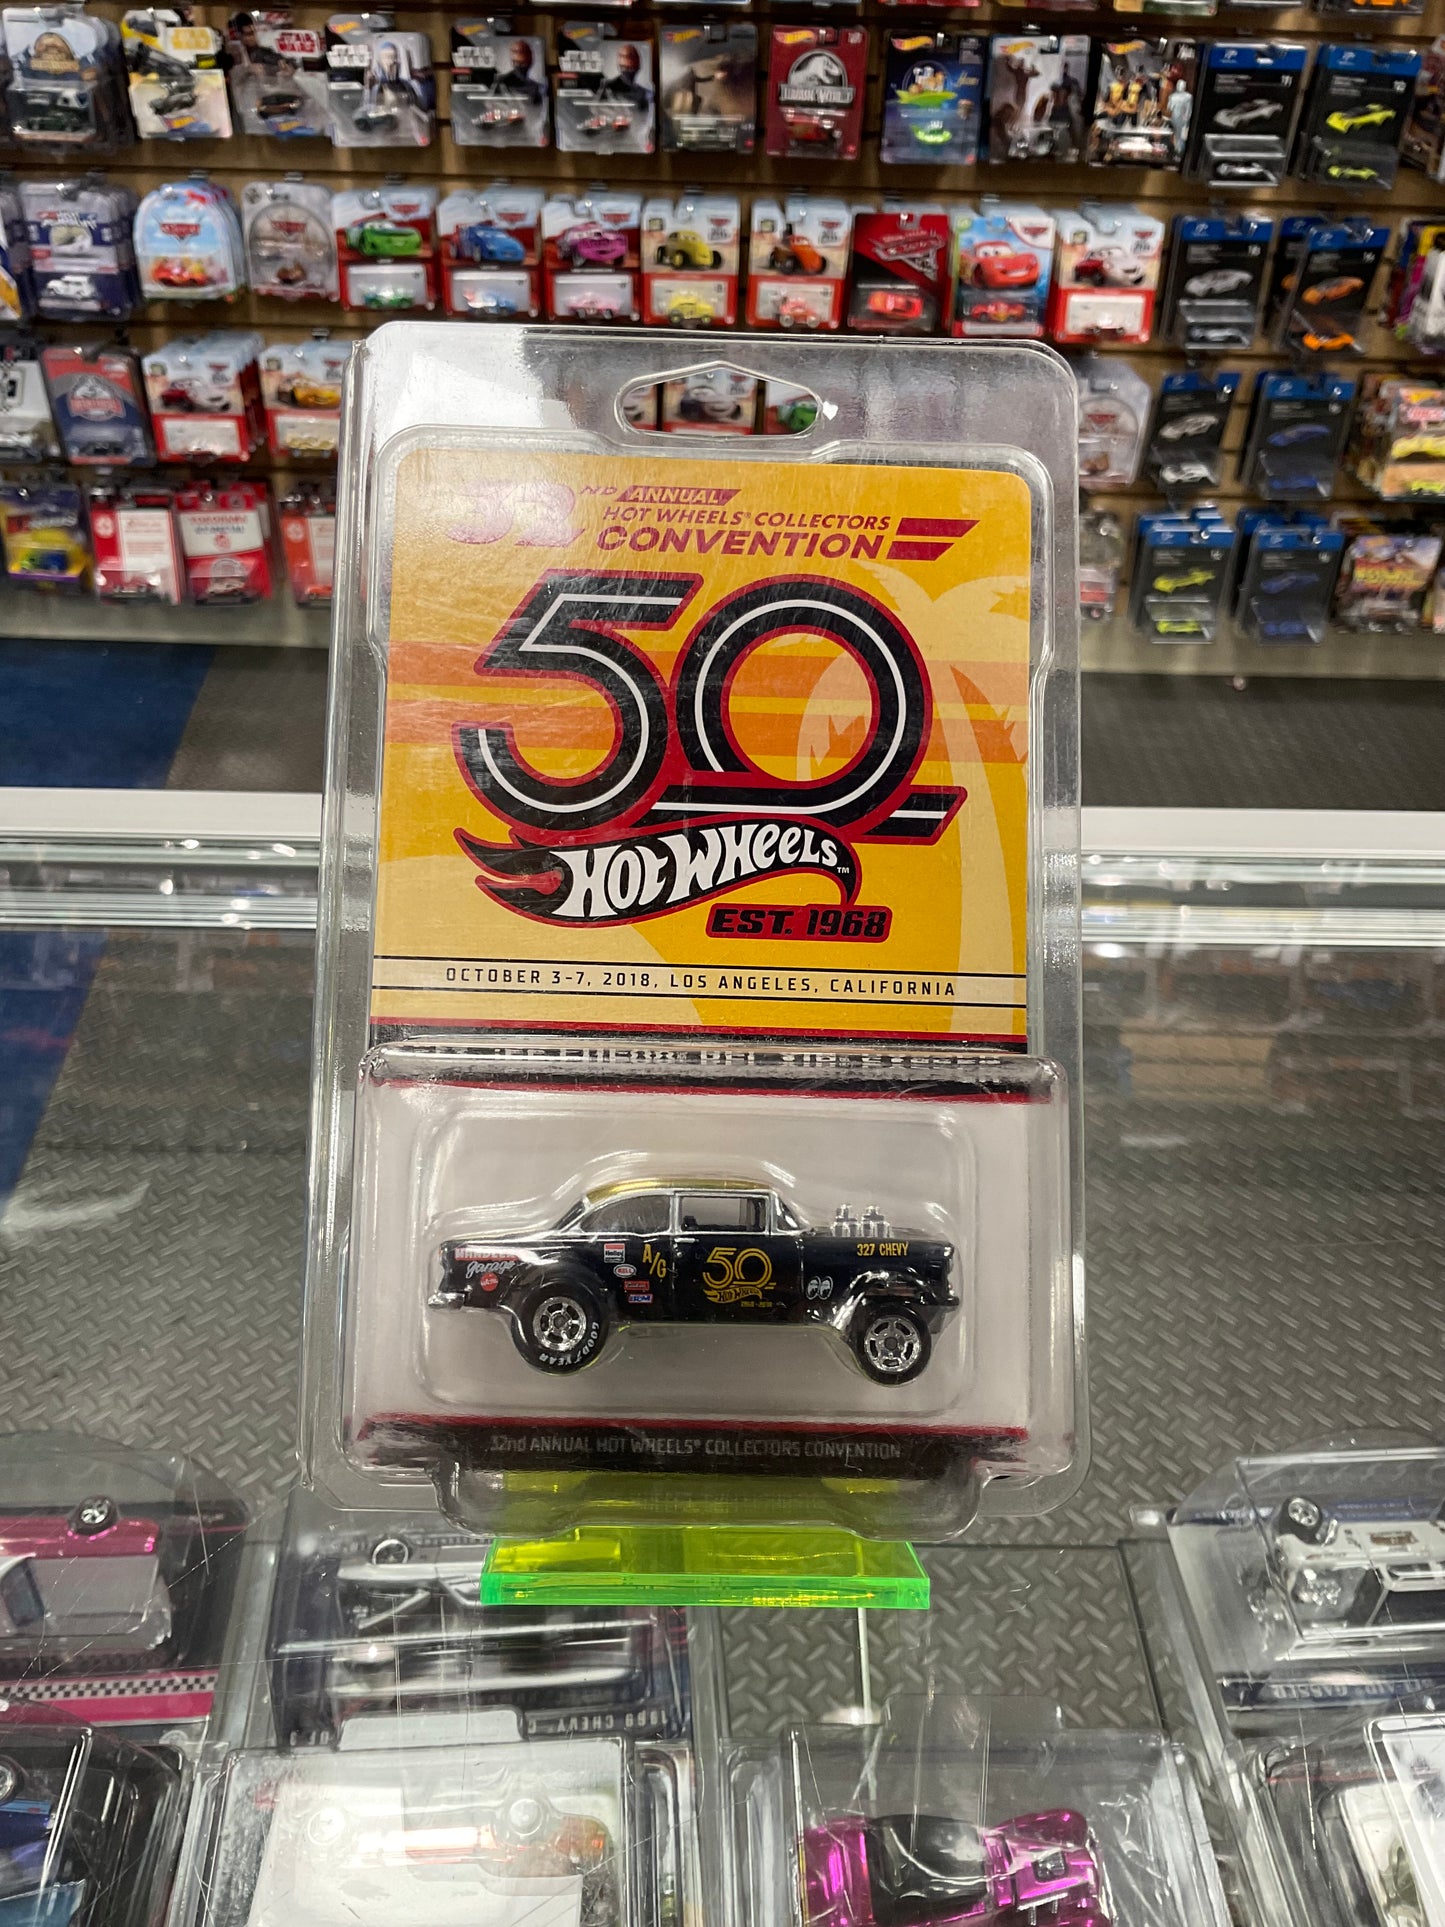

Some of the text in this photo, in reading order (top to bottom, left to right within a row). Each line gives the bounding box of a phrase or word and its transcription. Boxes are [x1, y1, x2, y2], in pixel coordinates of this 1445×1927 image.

[627, 486, 719, 505] ANNUAL
[603, 506, 652, 522] HOT
[754, 512, 891, 530] COLLECTORS
[596, 525, 885, 560] CONVENTION
[453, 569, 966, 843] 50
[711, 908, 887, 938] EST. 1968
[446, 967, 956, 996] OCTOBER 3-7, 2018, LOS ANGELES, CALIFORNIA
[642, 1243, 667, 1278] A/G
[856, 1241, 909, 1257] 327 CHEVY
[702, 1246, 775, 1289] 50
[530, 1435, 590, 1453] ANNUAL
[597, 1437, 626, 1453] HOT
[705, 1439, 801, 1457] COLLECTORS
[804, 1441, 901, 1458] CONVENTION
